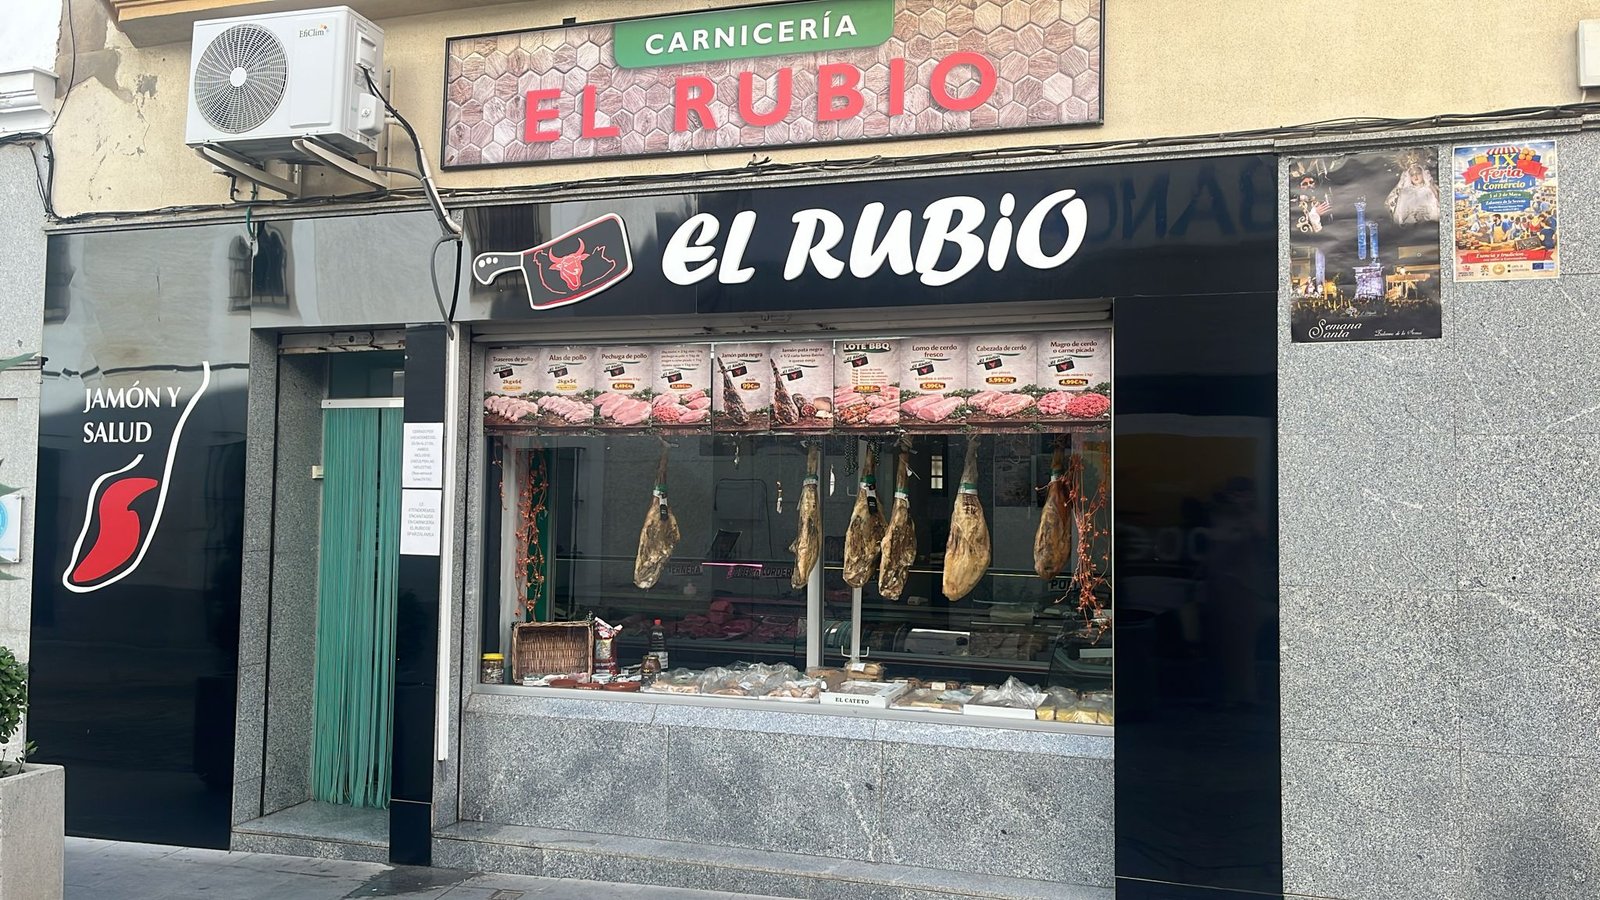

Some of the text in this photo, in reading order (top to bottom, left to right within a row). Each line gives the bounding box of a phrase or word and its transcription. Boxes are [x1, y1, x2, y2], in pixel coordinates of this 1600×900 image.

[299, 28, 325, 38] EfiClim
[645, 11, 858, 56] CARNICERÍA
[524, 53, 997, 143] EL RUBIO
[1492, 153, 1517, 168] IX
[1480, 167, 1524, 181] Feria
[1482, 180, 1526, 190] Comercio
[843, 342, 891, 351] LOTE BBQ
[1050, 341, 1070, 349] Magro
[572, 354, 587, 362] pollo
[601, 353, 626, 361] Pechuga
[633, 353, 648, 361] pollo
[82, 380, 182, 414] JAMÓN Y
[83, 421, 153, 443] SALUD
[844, 697, 870, 705] CATETO
